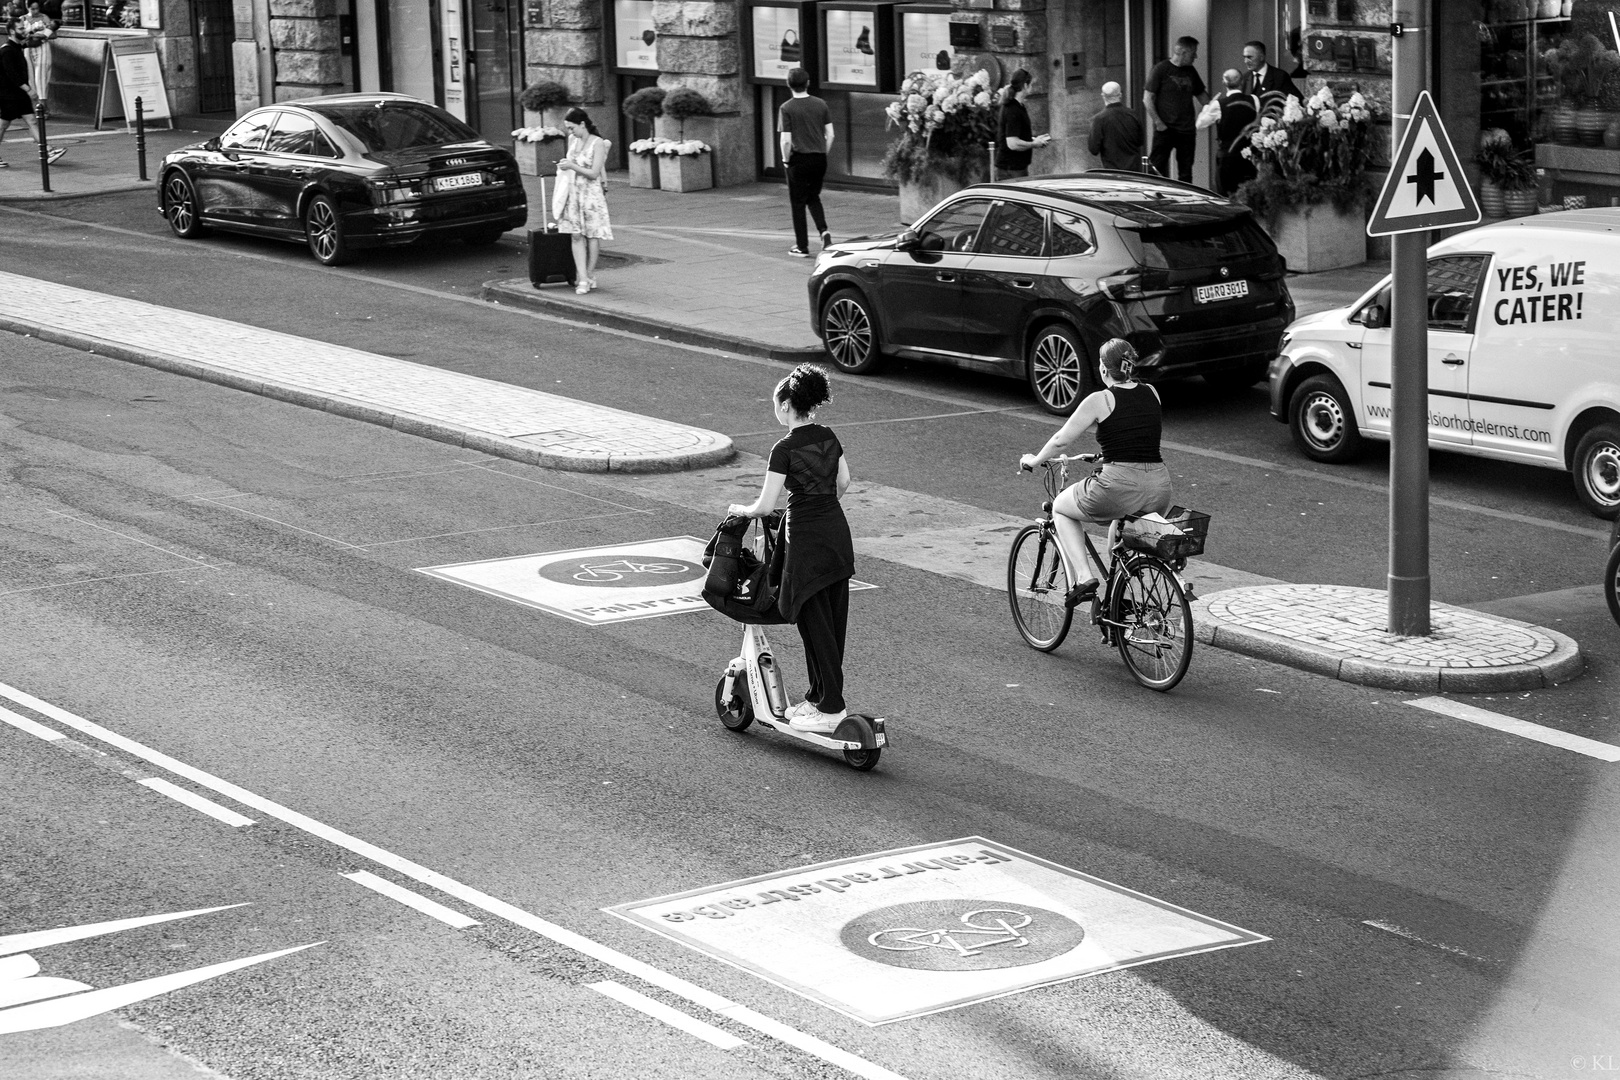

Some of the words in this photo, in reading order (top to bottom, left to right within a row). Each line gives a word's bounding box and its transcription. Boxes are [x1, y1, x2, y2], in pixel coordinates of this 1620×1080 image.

[1497, 265, 1543, 292] YES,
[1550, 261, 1586, 287] WE
[1494, 292, 1583, 326] CATER!
